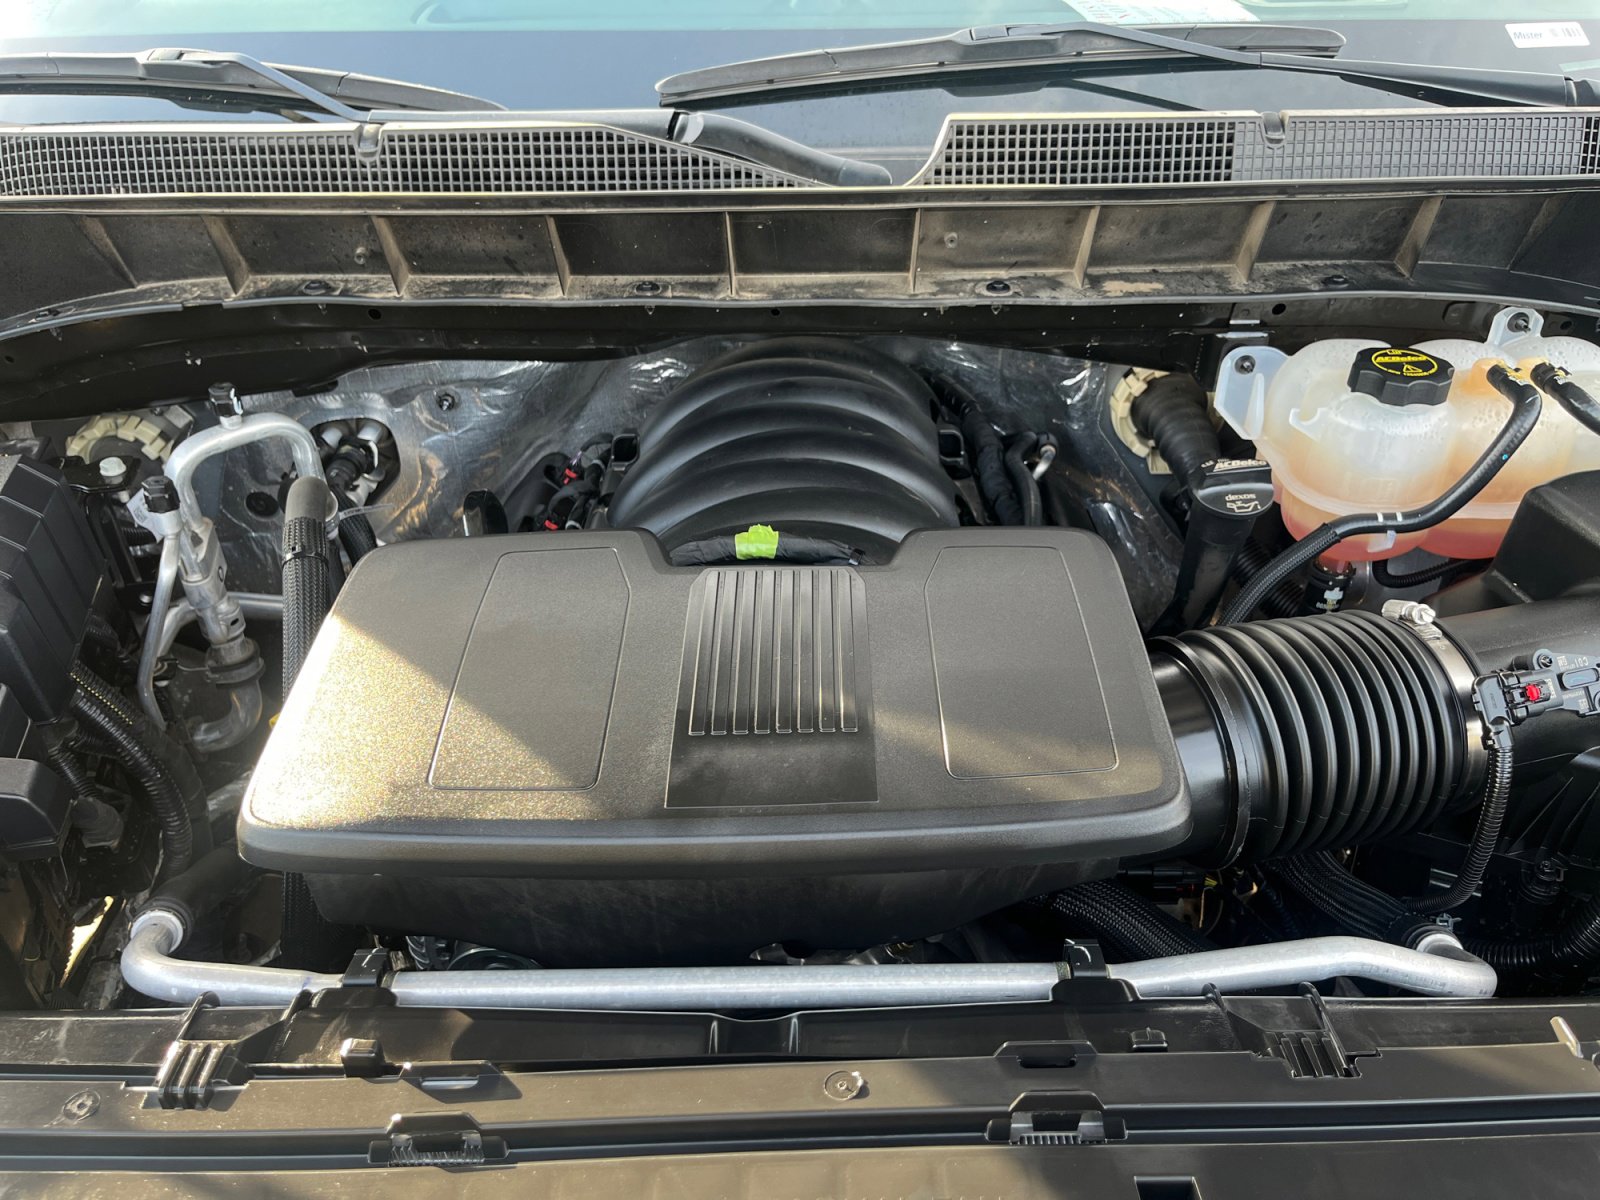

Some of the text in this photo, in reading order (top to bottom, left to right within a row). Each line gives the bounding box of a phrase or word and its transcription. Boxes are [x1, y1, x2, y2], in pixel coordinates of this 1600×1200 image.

[1513, 31, 1542, 40] Mister
[1375, 355, 1427, 363] ACDelco
[1214, 459, 1267, 471] ACDelco
